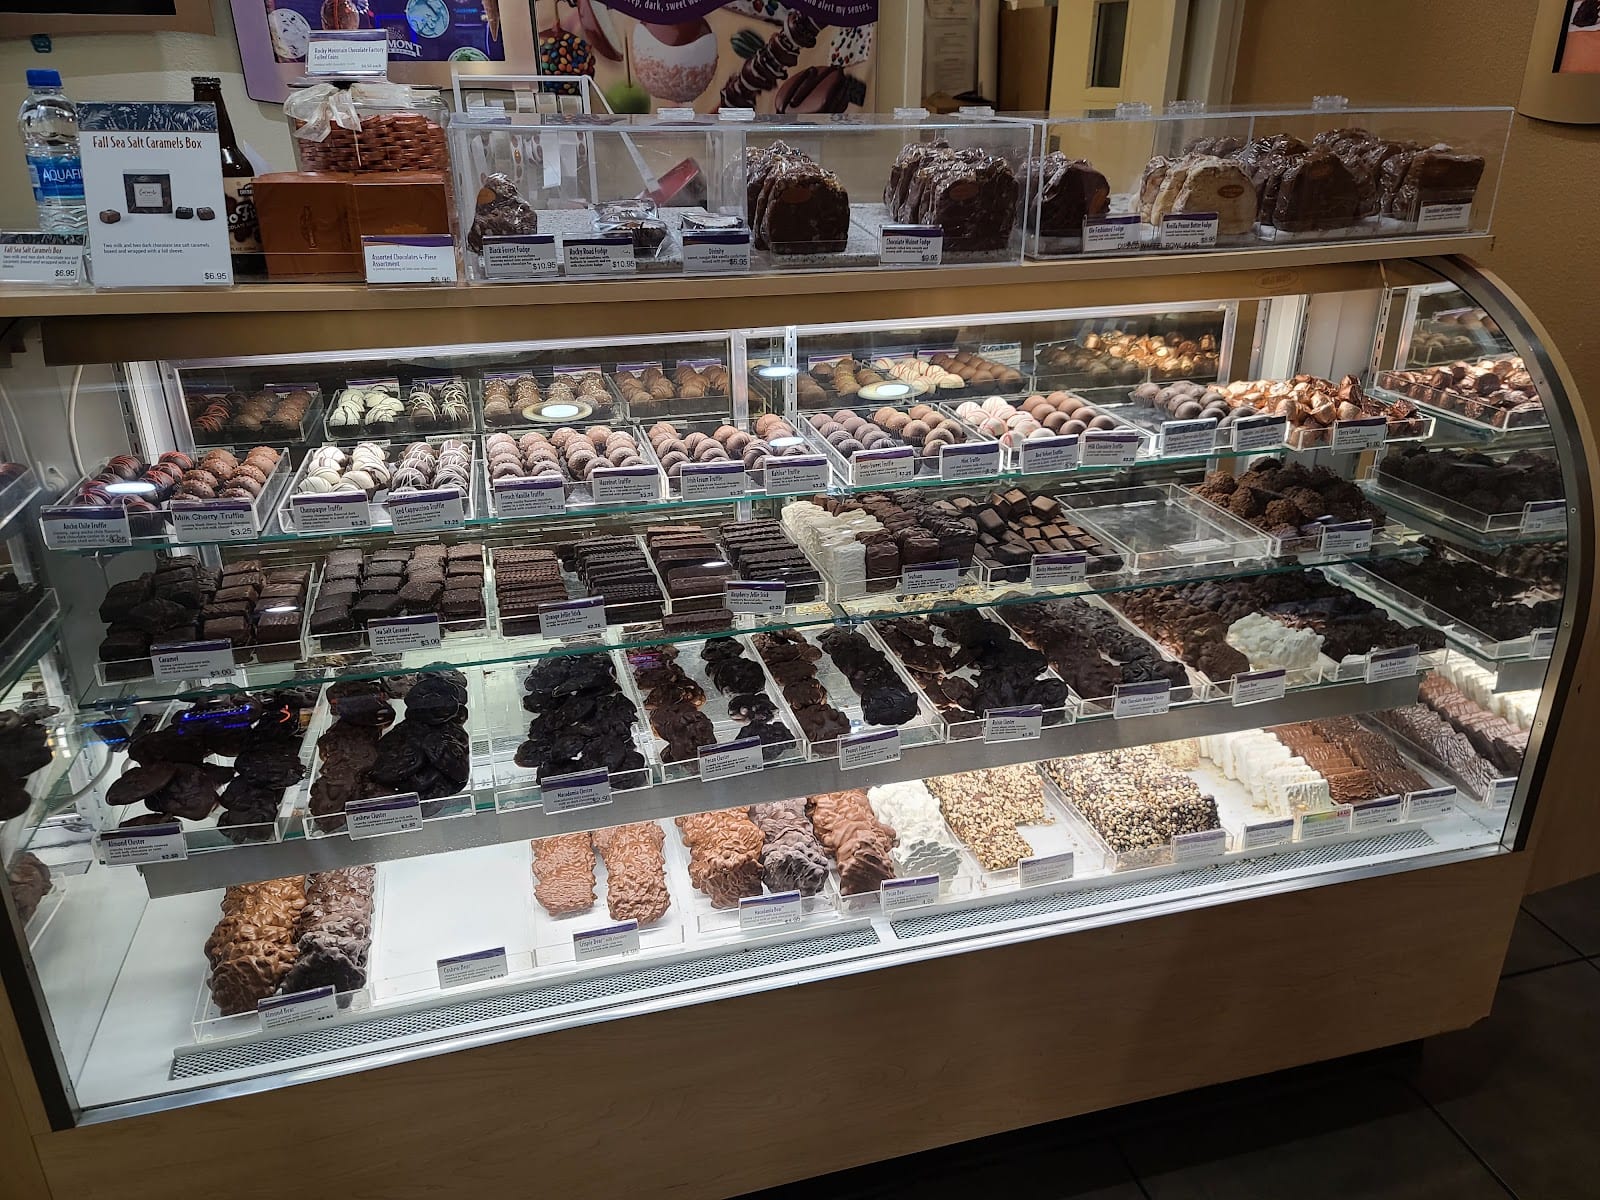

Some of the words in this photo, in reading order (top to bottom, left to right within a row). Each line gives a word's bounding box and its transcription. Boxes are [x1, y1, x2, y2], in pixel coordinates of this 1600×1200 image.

[645, 2, 664, 12] dark,
[667, 1, 687, 11] sweet
[818, 1, 834, 12] alert
[836, 6, 846, 16] my
[848, 3, 873, 14] senses.
[388, 39, 424, 57] MONT
[93, 136, 109, 148] Fall
[111, 137, 126, 149] Sea
[128, 137, 144, 149] Salt
[146, 137, 184, 149] Caramels
[186, 138, 202, 149] Box
[43, 167, 84, 183] AQUAFI
[886, 238, 905, 246] Chocolate
[920, 238, 932, 247] Fudge
[4, 246, 13, 254] Fall
[14, 246, 22, 254] Sea
[22, 246, 32, 254] Salt
[32, 246, 52, 254] Caramels
[488, 246, 501, 254] Black
[502, 246, 516, 254] Forest
[517, 246, 531, 255] Fudge
[569, 248, 583, 257] Rocky
[583, 247, 595, 256] Road
[595, 247, 608, 256] Fudge
[372, 253, 393, 262] Assorted
[394, 253, 419, 262] Chocolates
[532, 262, 557, 271] $10.95
[612, 260, 636, 269] $10.95
[55, 269, 75, 277] $6.95
[204, 272, 227, 281] $6.95
[882, 460, 895, 468] Truffle
[789, 467, 802, 476] Truffle
[599, 478, 617, 487] Hazelnut
[617, 476, 632, 485] Truffle
[710, 473, 724, 482] Truffle
[500, 492, 515, 501] French
[515, 491, 531, 500] Vanilla
[531, 490, 546, 498] Truffle
[300, 505, 327, 514] Champagne
[328, 503, 344, 512] Truffle
[395, 506, 405, 515] Iced
[405, 504, 430, 514] Cappuccino
[431, 502, 446, 511] Truffle
[175, 513, 191, 521] Milk
[192, 512, 218, 521] Cherry
[219, 512, 245, 520] Truffle
[79, 522, 91, 530] Chile
[91, 521, 107, 530] Truffle
[444, 518, 460, 526] $3.25
[231, 527, 253, 536] $3.25
[545, 612, 561, 621] Orange
[383, 627, 392, 635] Salt
[393, 626, 410, 635] Caramel
[421, 639, 440, 647] $3.00
[159, 655, 179, 664] Caramel
[859, 744, 871, 753] Cluster
[705, 756, 717, 765] Pecan
[718, 754, 730, 762] Cluster
[580, 788, 593, 797] Cluster
[353, 814, 370, 822] Cashew
[371, 812, 387, 821] Cluster
[109, 839, 128, 848] Almond
[128, 838, 145, 847] Cluster
[755, 907, 775, 915] Macadamia
[444, 965, 461, 974] Cashew
[265, 1009, 283, 1019] Almond
